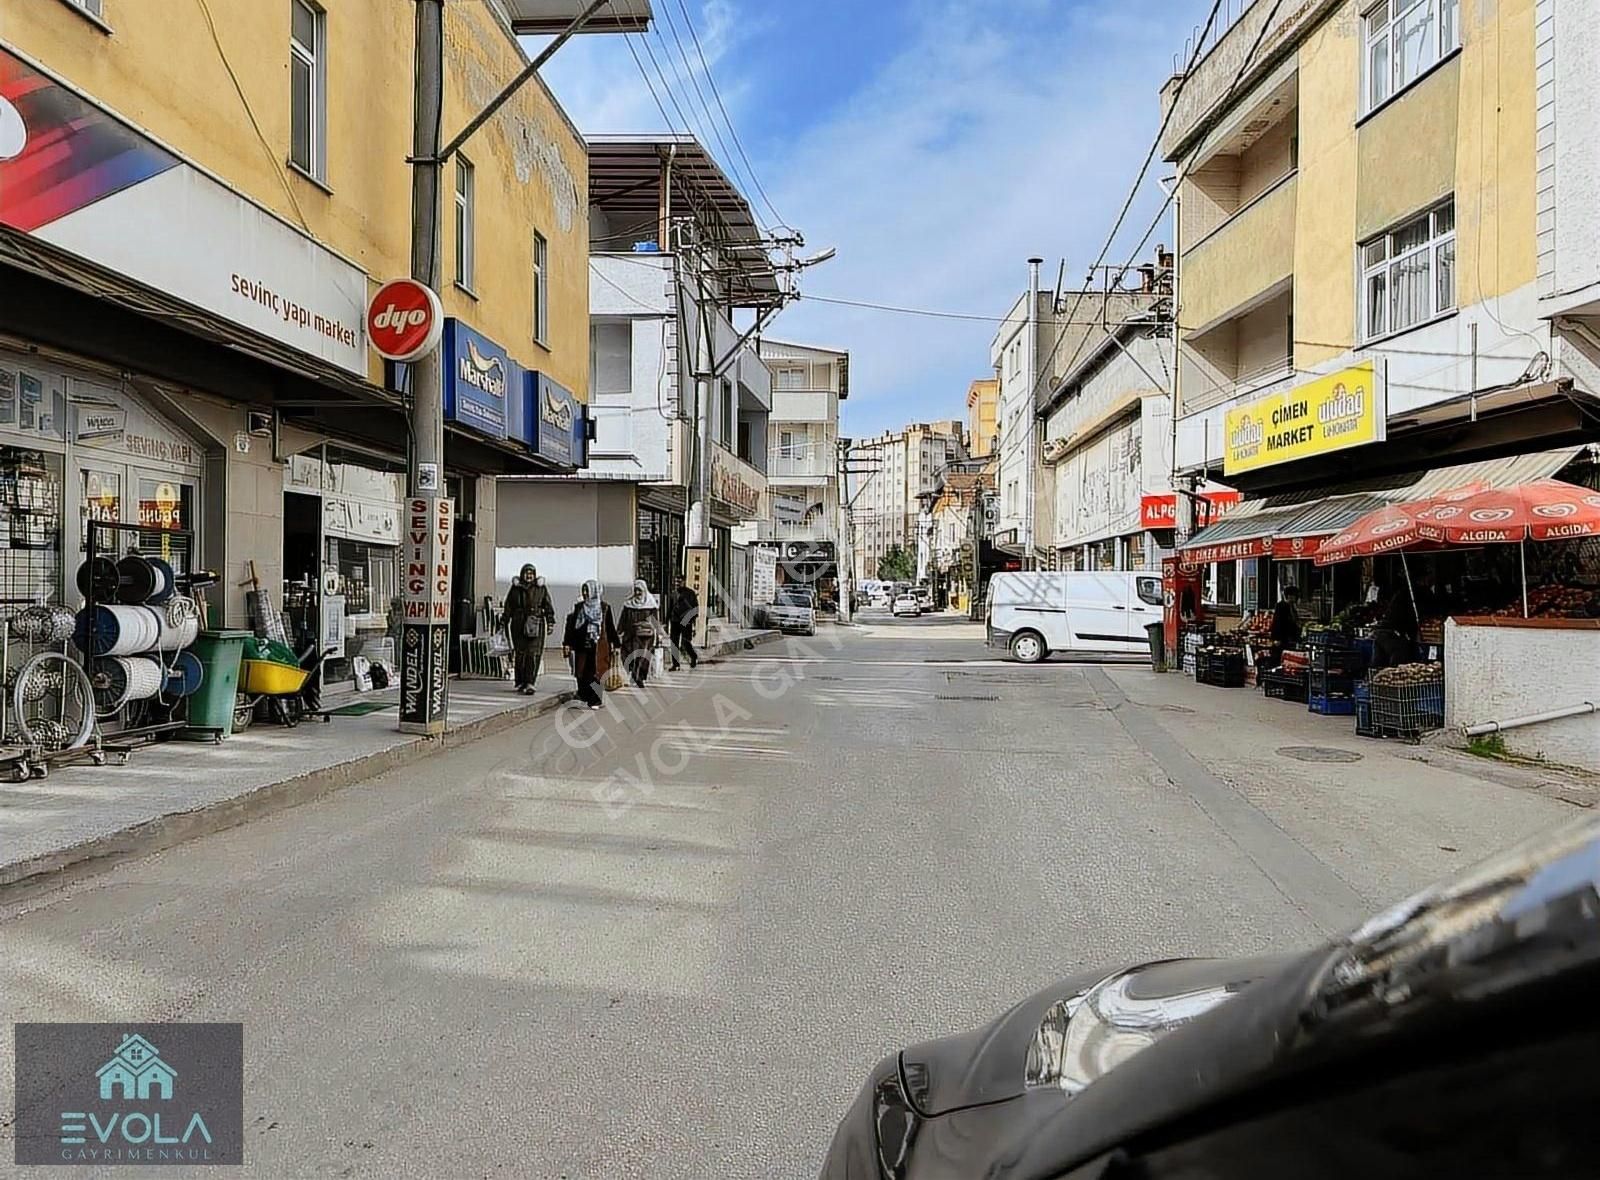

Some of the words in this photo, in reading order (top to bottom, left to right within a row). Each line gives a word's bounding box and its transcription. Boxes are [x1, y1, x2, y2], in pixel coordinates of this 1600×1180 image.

[231, 272, 279, 314] sevinç
[283, 297, 312, 329] yapı
[314, 315, 357, 349] market
[374, 304, 427, 334] dyo
[459, 357, 505, 398] Marshall
[1272, 400, 1308, 429] ÇİMEN
[1267, 425, 1314, 451] MARKET
[1373, 533, 1412, 552] ALGIDA
[1460, 530, 1506, 541] ALGIDA
[1547, 523, 1592, 537] ALGIDA
[409, 500, 428, 596] SEVİNÇ
[437, 502, 449, 596] SEVİNÇ
[1219, 543, 1253, 558] MARKET
[404, 601, 429, 618] YAPI
[404, 650, 420, 715] WANDEL
[432, 647, 444, 715] WANDEL
